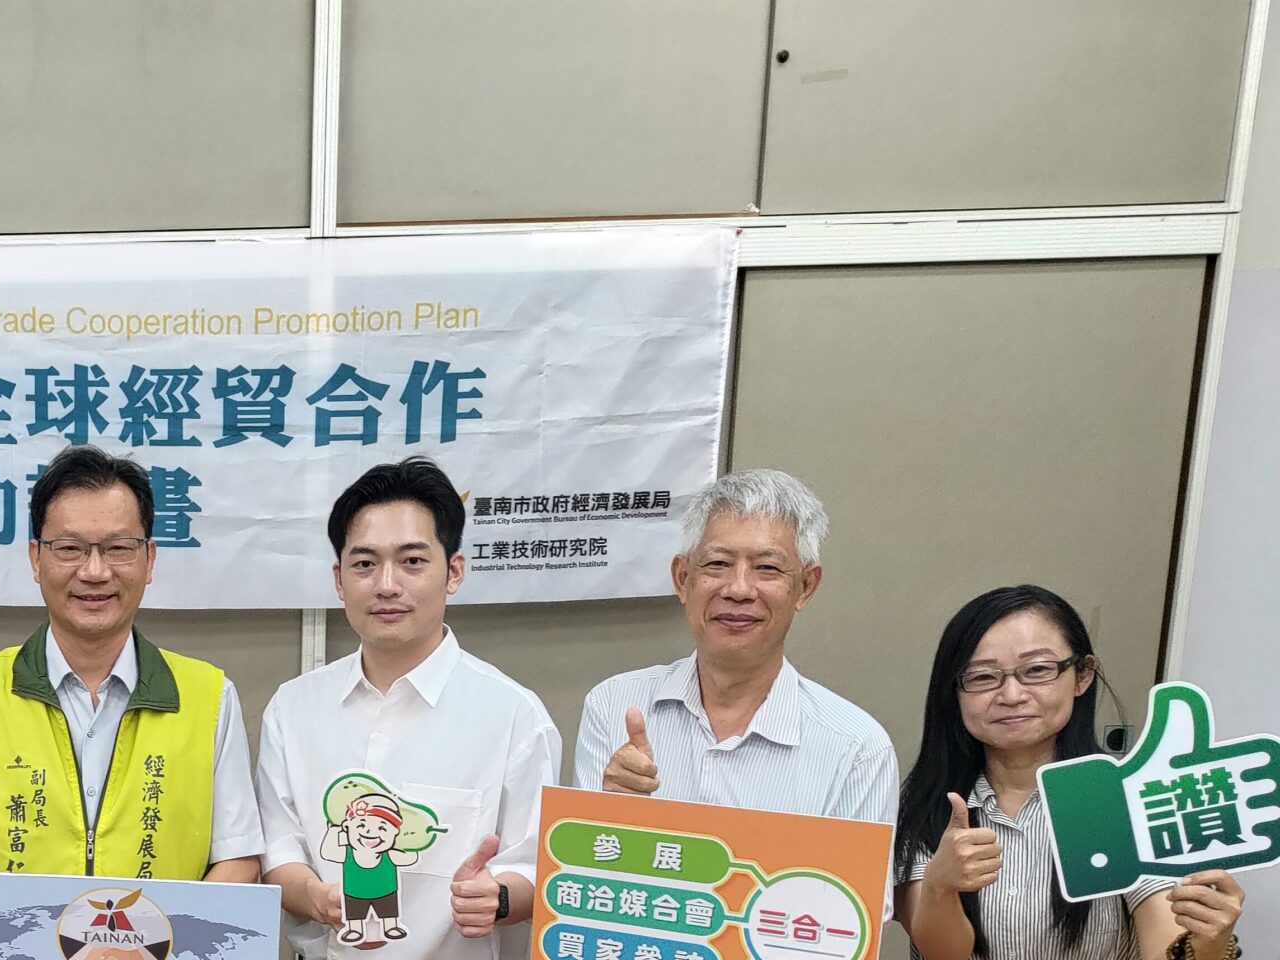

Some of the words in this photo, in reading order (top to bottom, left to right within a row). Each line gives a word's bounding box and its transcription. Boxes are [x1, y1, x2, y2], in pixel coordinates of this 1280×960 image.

[66, 306, 243, 342] Cooperation
[254, 304, 403, 335] Promotion
[415, 302, 480, 330] Plan
[473, 490, 671, 517] 臺南市政府經濟發展局
[473, 518, 496, 526] Tainan
[497, 517, 511, 526] City
[512, 516, 552, 524] Government
[554, 515, 578, 523] Bureau
[587, 512, 620, 521] Economic
[621, 511, 668, 520] Development
[471, 537, 608, 560] 工業技術研究院
[471, 563, 505, 572] Industrial
[506, 562, 544, 572] Technology
[545, 561, 577, 570] Research
[578, 560, 608, 569] Institute
[30, 768, 49, 828] 副局長
[1138, 766, 1247, 860] 讚
[555, 879, 715, 930] 商洽媒合會
[81, 930, 145, 945] TAINAN
[756, 909, 856, 941] 三合一
